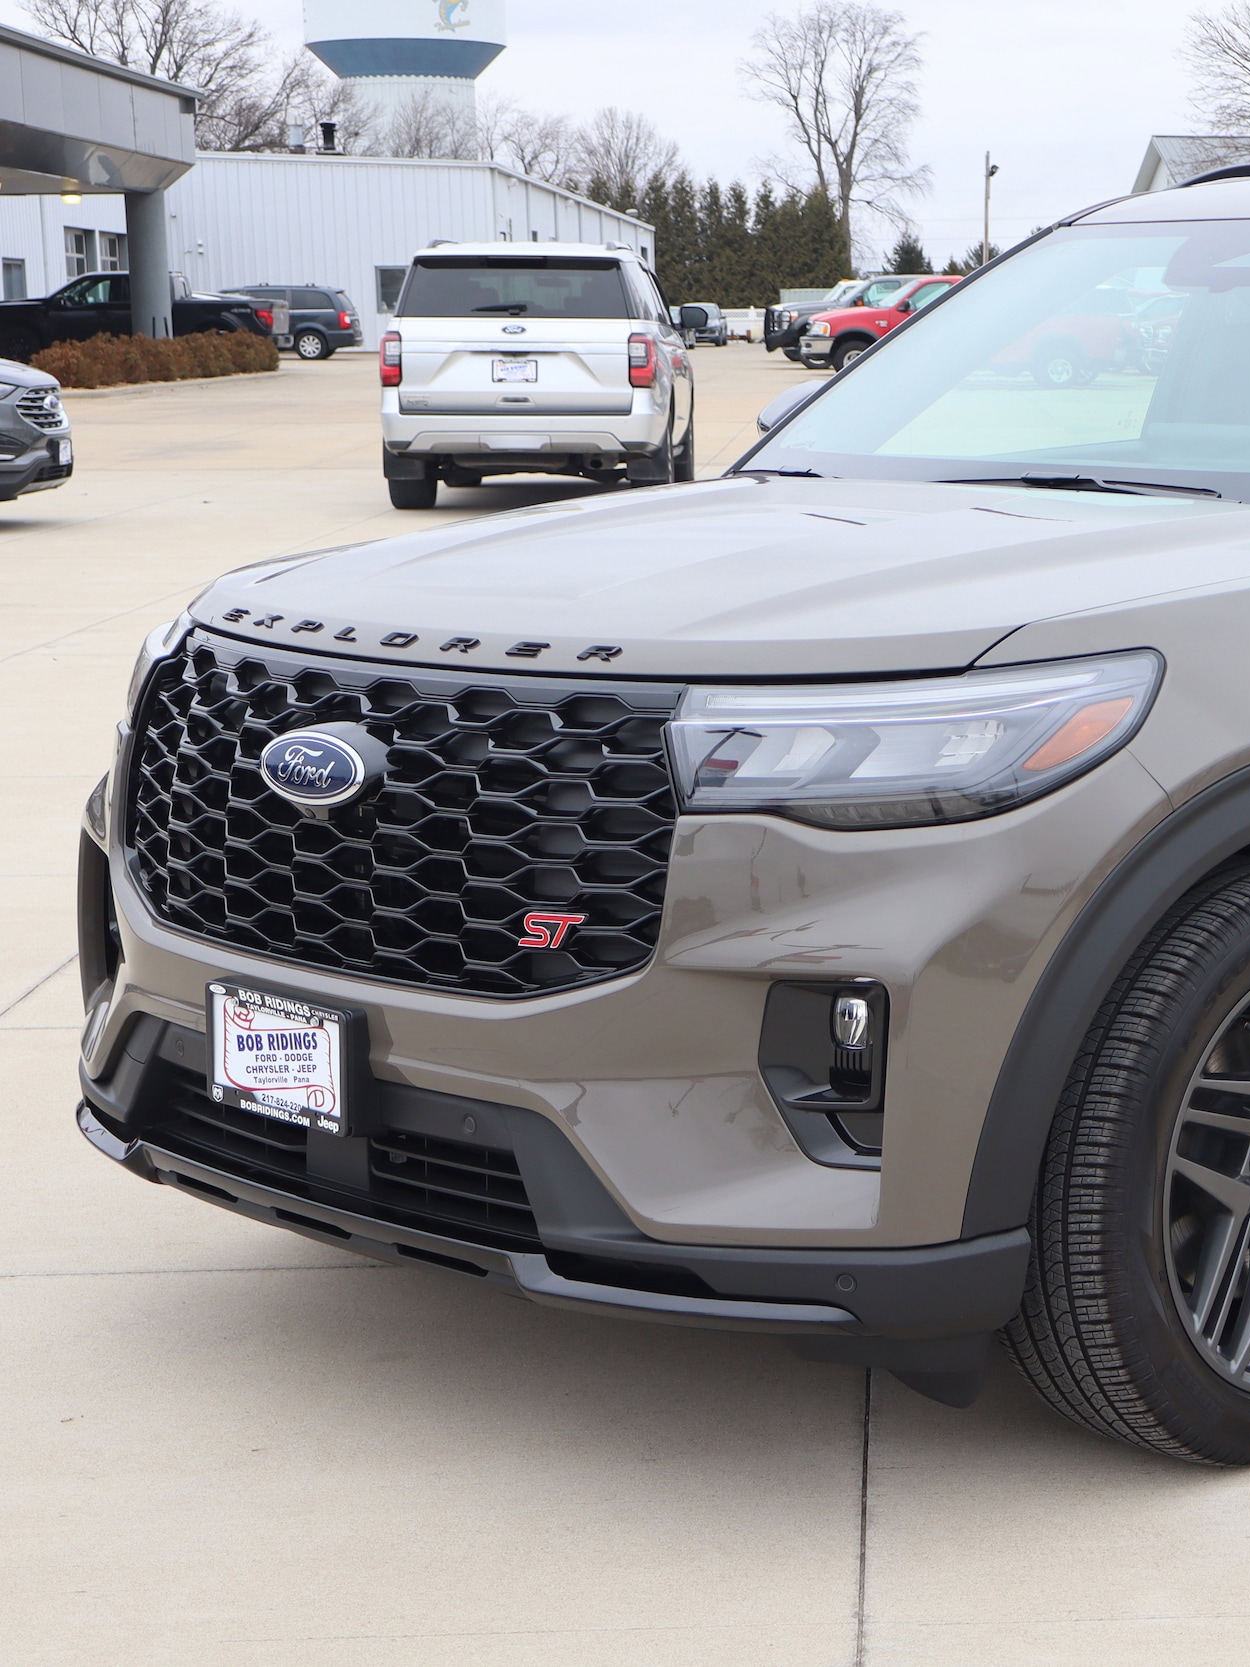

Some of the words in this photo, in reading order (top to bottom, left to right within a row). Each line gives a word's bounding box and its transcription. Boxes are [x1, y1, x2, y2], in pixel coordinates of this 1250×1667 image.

[222, 607, 623, 663] EXPLORER
[278, 744, 335, 788] Ford
[518, 912, 585, 949] ST
[238, 989, 262, 1005] BOB
[264, 996, 311, 1017] RIDINGS
[246, 1002, 285, 1019] TAYLORVILLE
[290, 1013, 308, 1024] PANA
[236, 1034, 264, 1052] BOB
[267, 1031, 318, 1051] RIDINGS
[255, 1053, 277, 1062] FORD
[284, 1053, 313, 1062] DODGE
[245, 1064, 290, 1074] CHRYSLER
[296, 1064, 317, 1073] JEEP
[253, 1076, 288, 1085] Taylorville
[240, 1098, 311, 1128] BOBRIDINGS.COM
[261, 1093, 304, 1112] 217-824-220
[317, 1115, 339, 1133] Jeep
